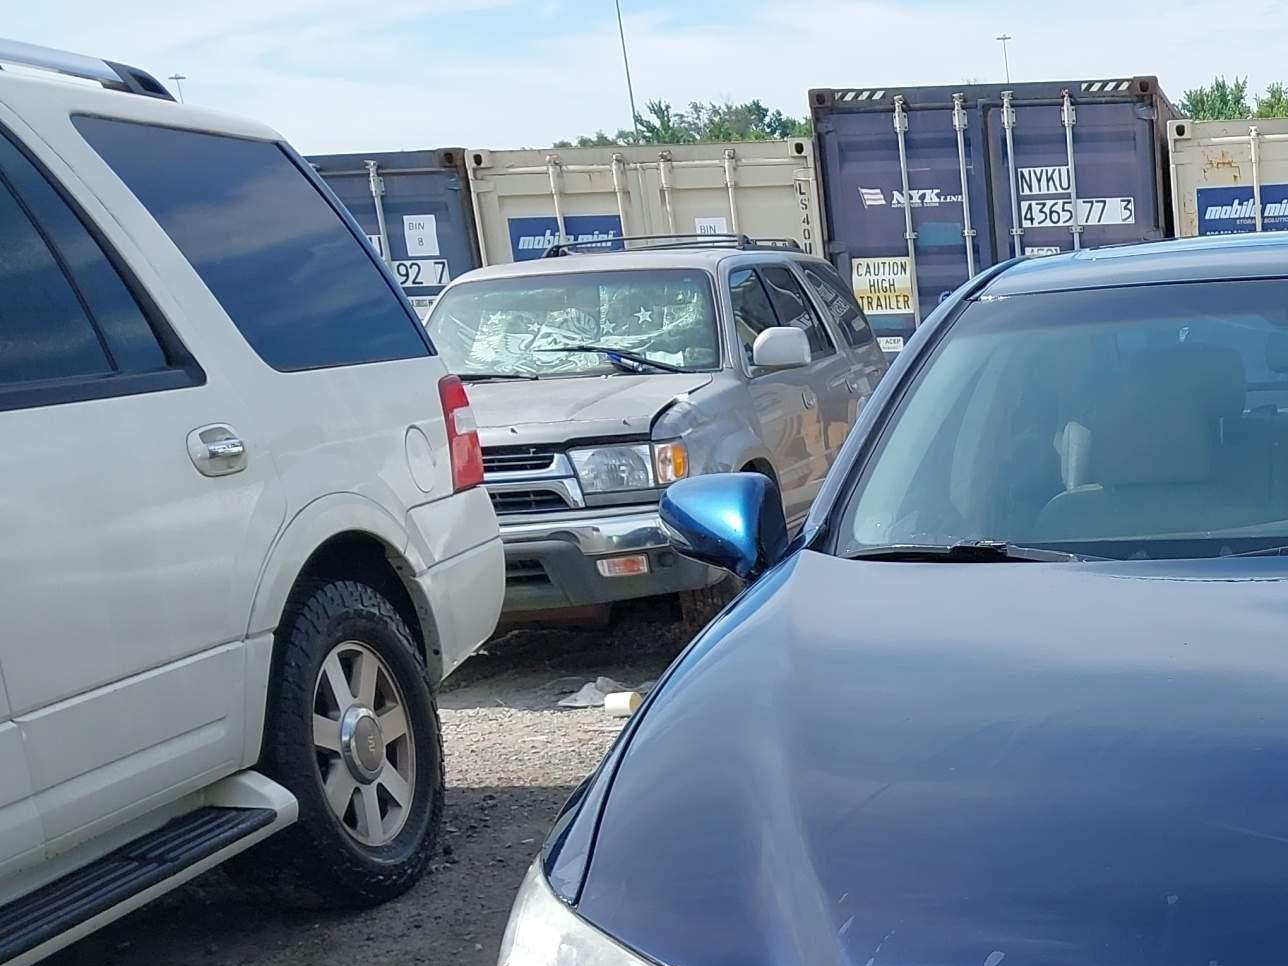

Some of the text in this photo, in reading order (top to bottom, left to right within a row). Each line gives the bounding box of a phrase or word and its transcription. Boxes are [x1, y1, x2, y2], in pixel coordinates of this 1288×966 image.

[1019, 167, 1071, 193] NYKU
[892, 189, 940, 204] NYK
[408, 222, 425, 231] BIN
[699, 225, 717, 234] BIN
[518, 229, 575, 249] mobi
[396, 261, 446, 285] 92 7
[856, 261, 907, 277] CAUTION
[868, 278, 897, 293] HIGH
[859, 294, 911, 311] TRAILER
